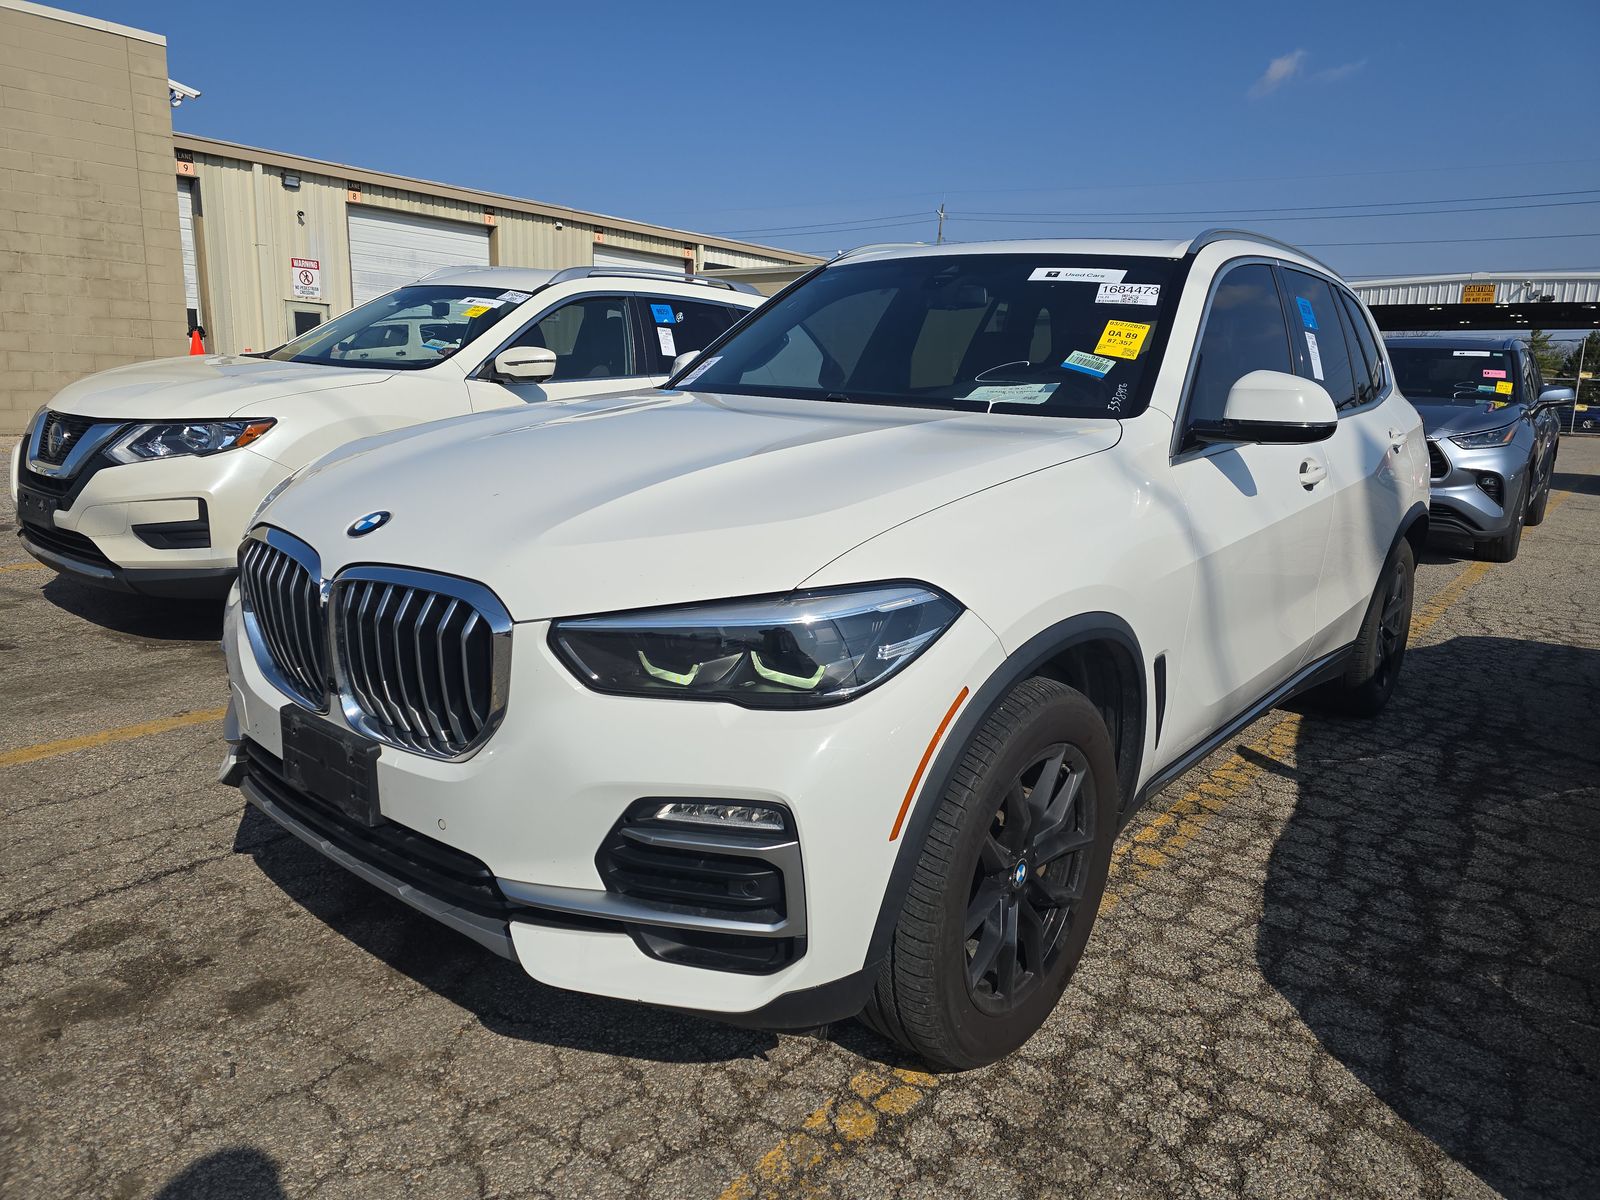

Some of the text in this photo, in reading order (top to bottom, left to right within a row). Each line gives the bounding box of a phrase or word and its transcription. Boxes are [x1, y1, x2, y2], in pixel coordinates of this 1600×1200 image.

[352, 192, 357, 200] 8
[293, 259, 318, 269] WARNING
[1103, 285, 1160, 295] 1684473
[1109, 321, 1146, 330] 03/27/2026
